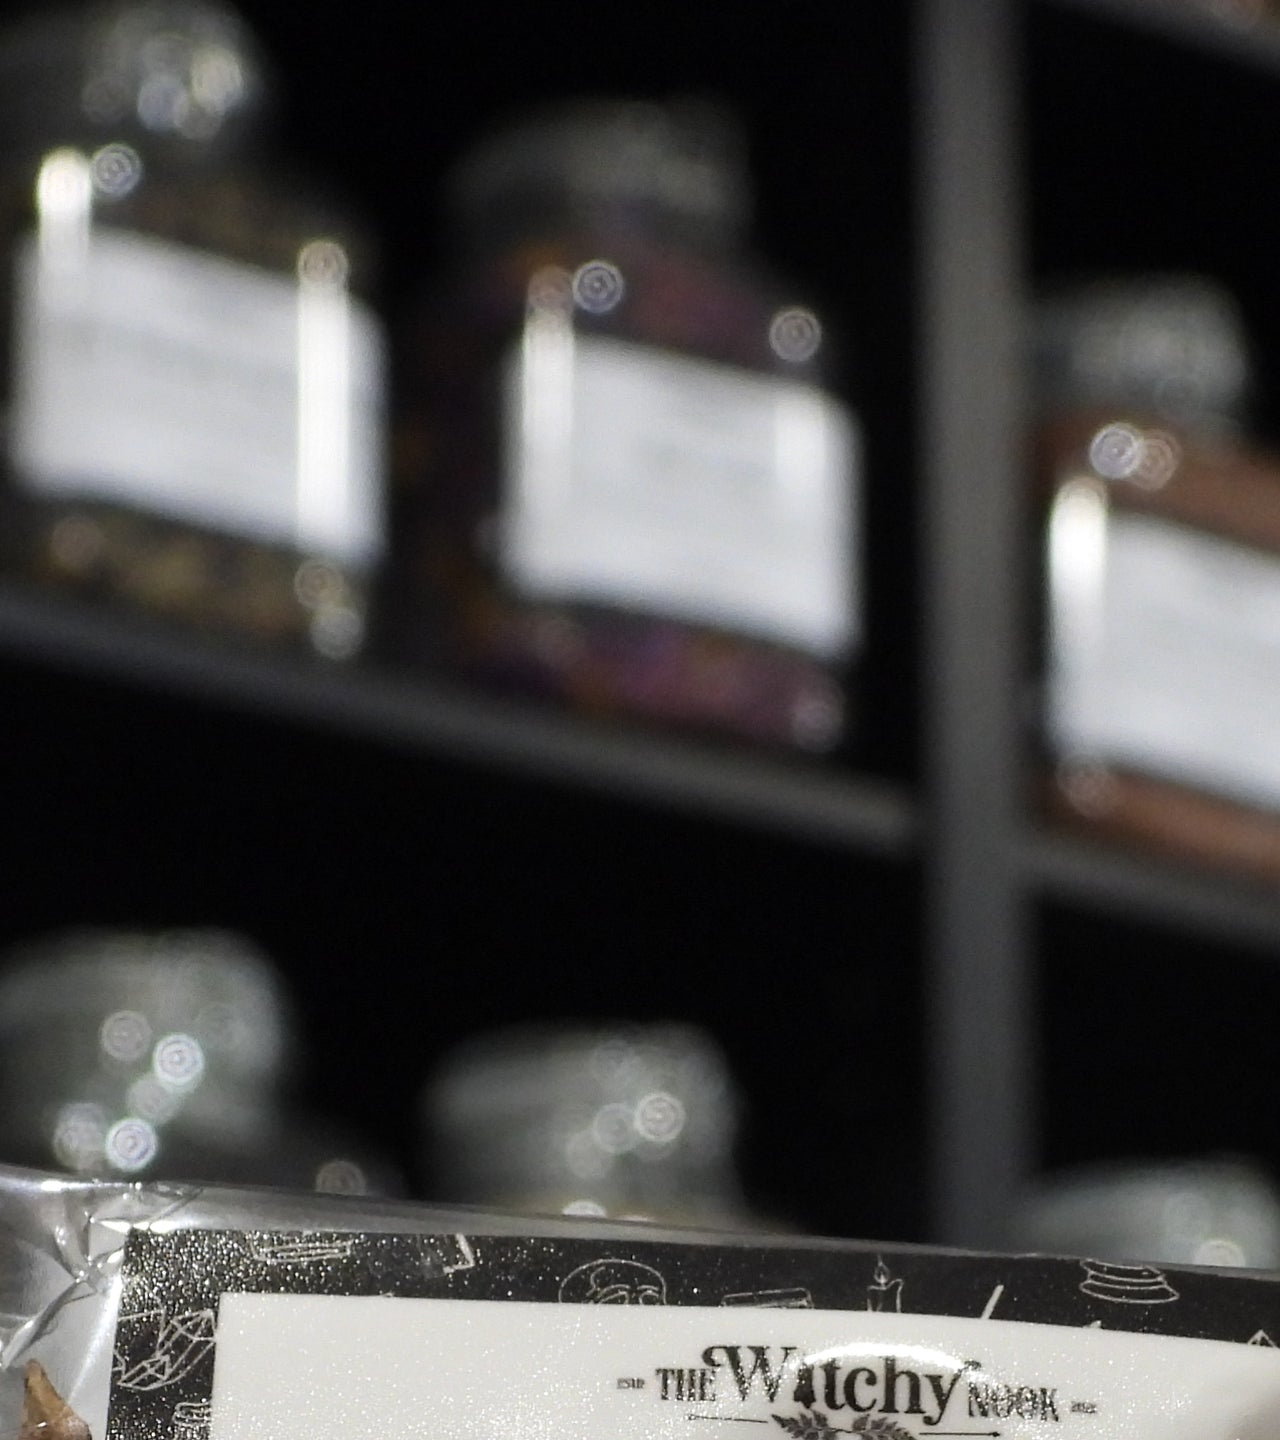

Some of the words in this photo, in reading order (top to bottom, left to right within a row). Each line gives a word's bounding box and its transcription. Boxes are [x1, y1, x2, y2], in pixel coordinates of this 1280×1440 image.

[654, 1367, 717, 1402] THE
[701, 1345, 982, 1426] Witchy
[967, 1381, 1060, 1423] NOOK
